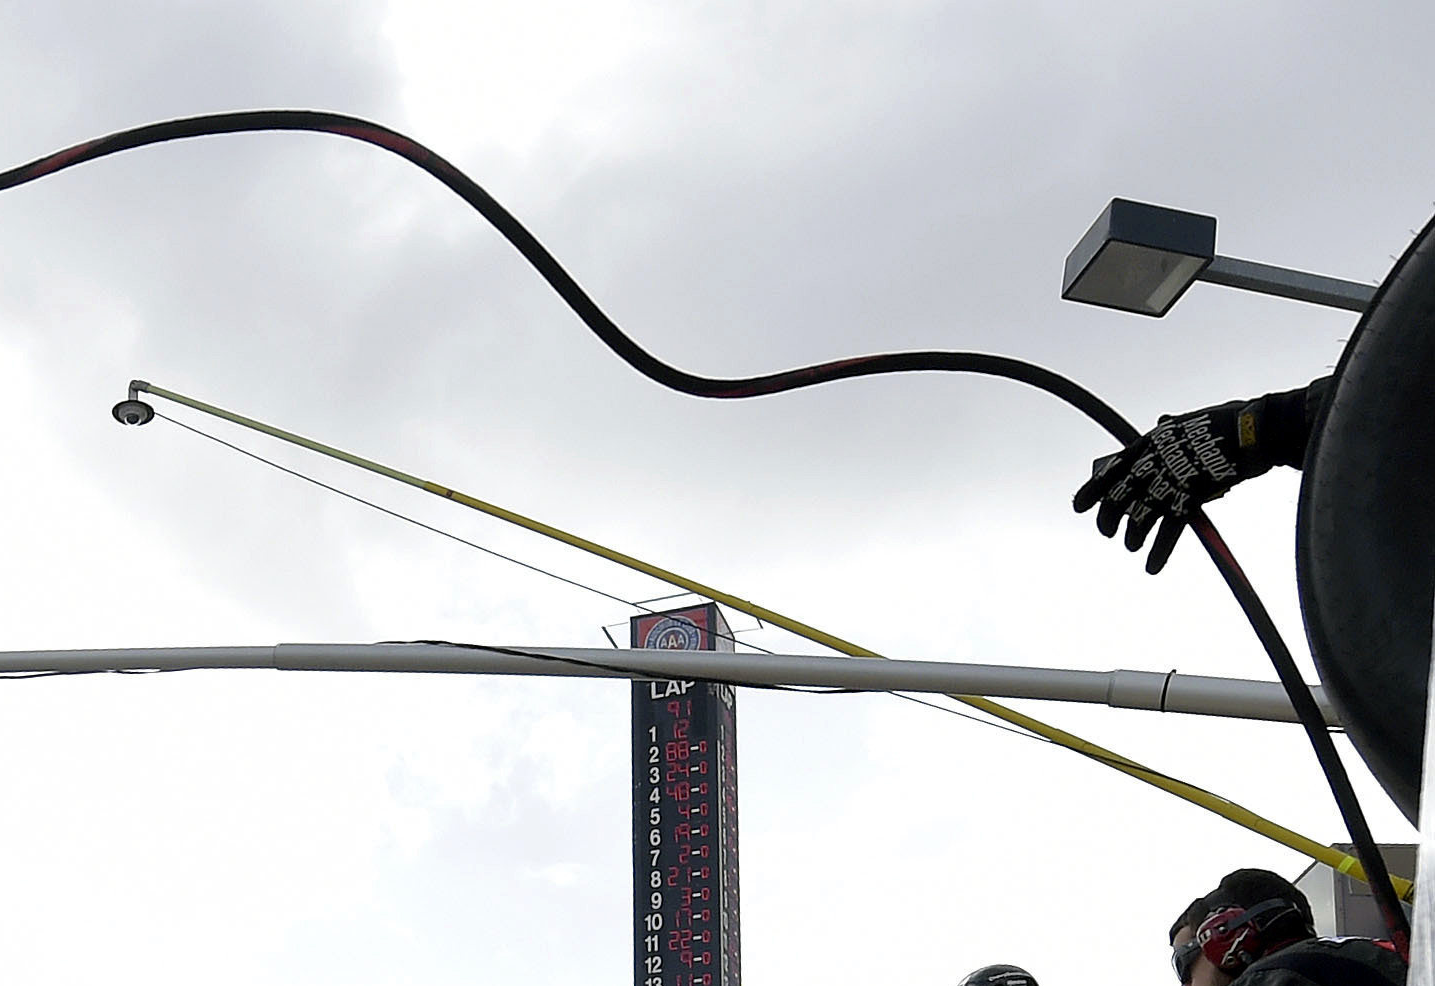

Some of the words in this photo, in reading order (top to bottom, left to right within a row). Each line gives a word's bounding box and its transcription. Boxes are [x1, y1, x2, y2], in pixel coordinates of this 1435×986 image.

[1152, 419, 1199, 486] Mechanix
[1183, 414, 1237, 481] Mechanix
[660, 634, 685, 648] AAA
[651, 679, 695, 700] LAP
[648, 726, 656, 743] 1
[649, 746, 660, 764] 2
[649, 766, 660, 784] 3
[649, 787, 661, 804] 4
[649, 807, 661, 825] 5
[649, 828, 661, 846] 6
[650, 849, 661, 867] 7
[650, 870, 662, 888] 8
[651, 892, 662, 910] 9
[644, 913, 663, 932] 10
[644, 934, 659, 953] 11
[644, 956, 662, 974] 12
